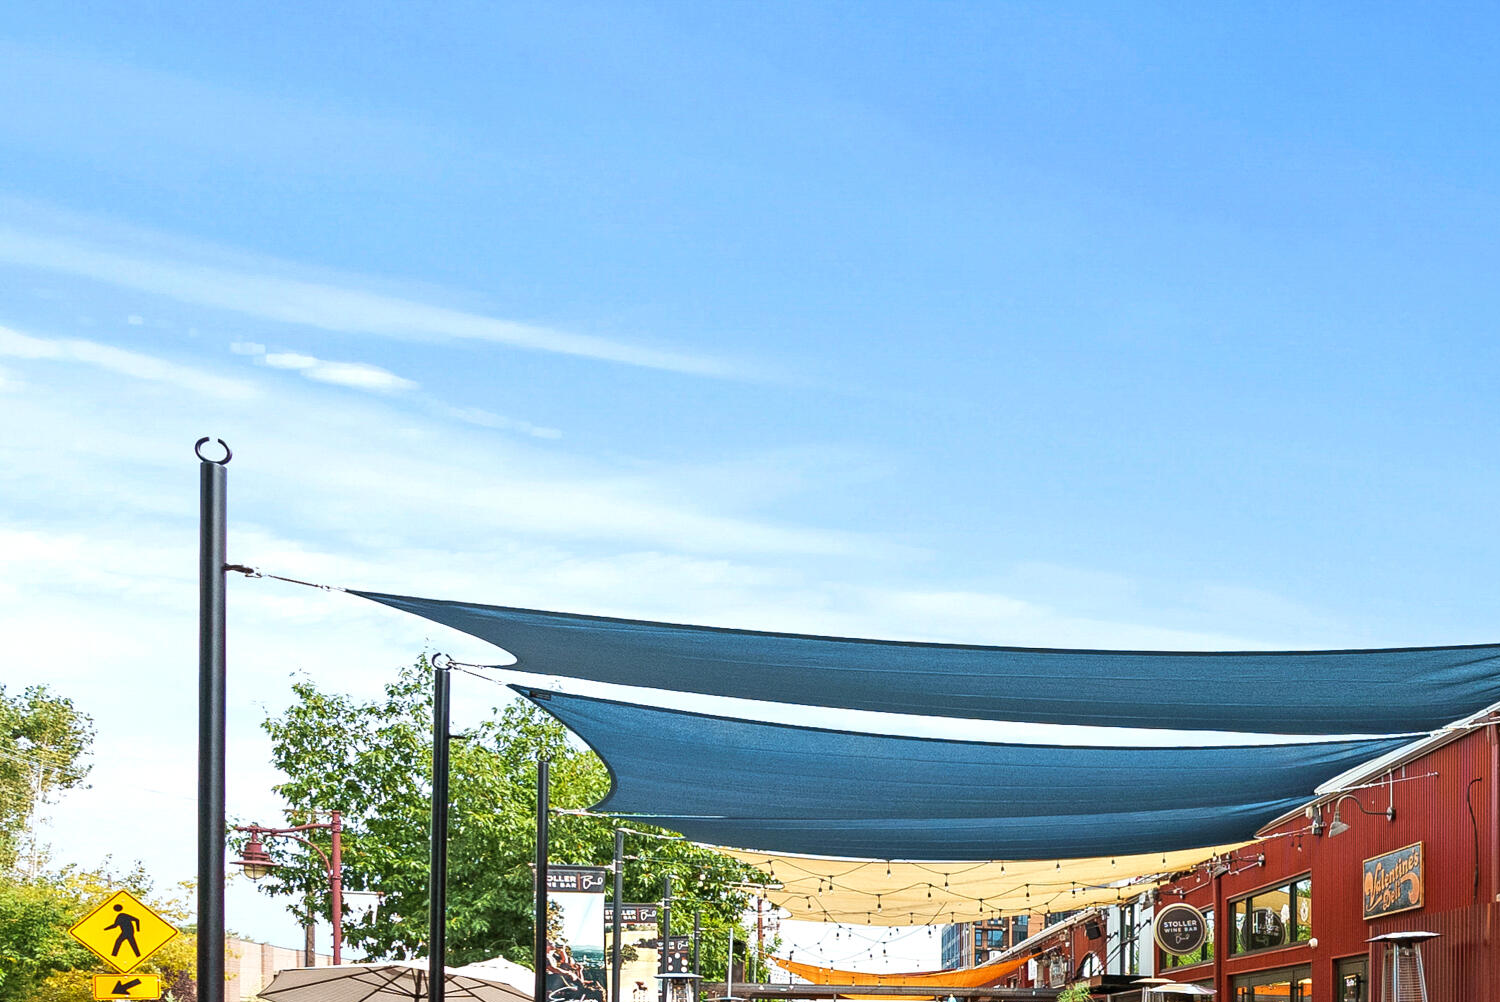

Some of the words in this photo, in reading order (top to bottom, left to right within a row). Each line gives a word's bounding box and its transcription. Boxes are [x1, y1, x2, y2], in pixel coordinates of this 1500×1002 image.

[1365, 848, 1419, 911] Valentine's
[1383, 881, 1401, 911] Deli
[1163, 920, 1197, 928] STOLLER
